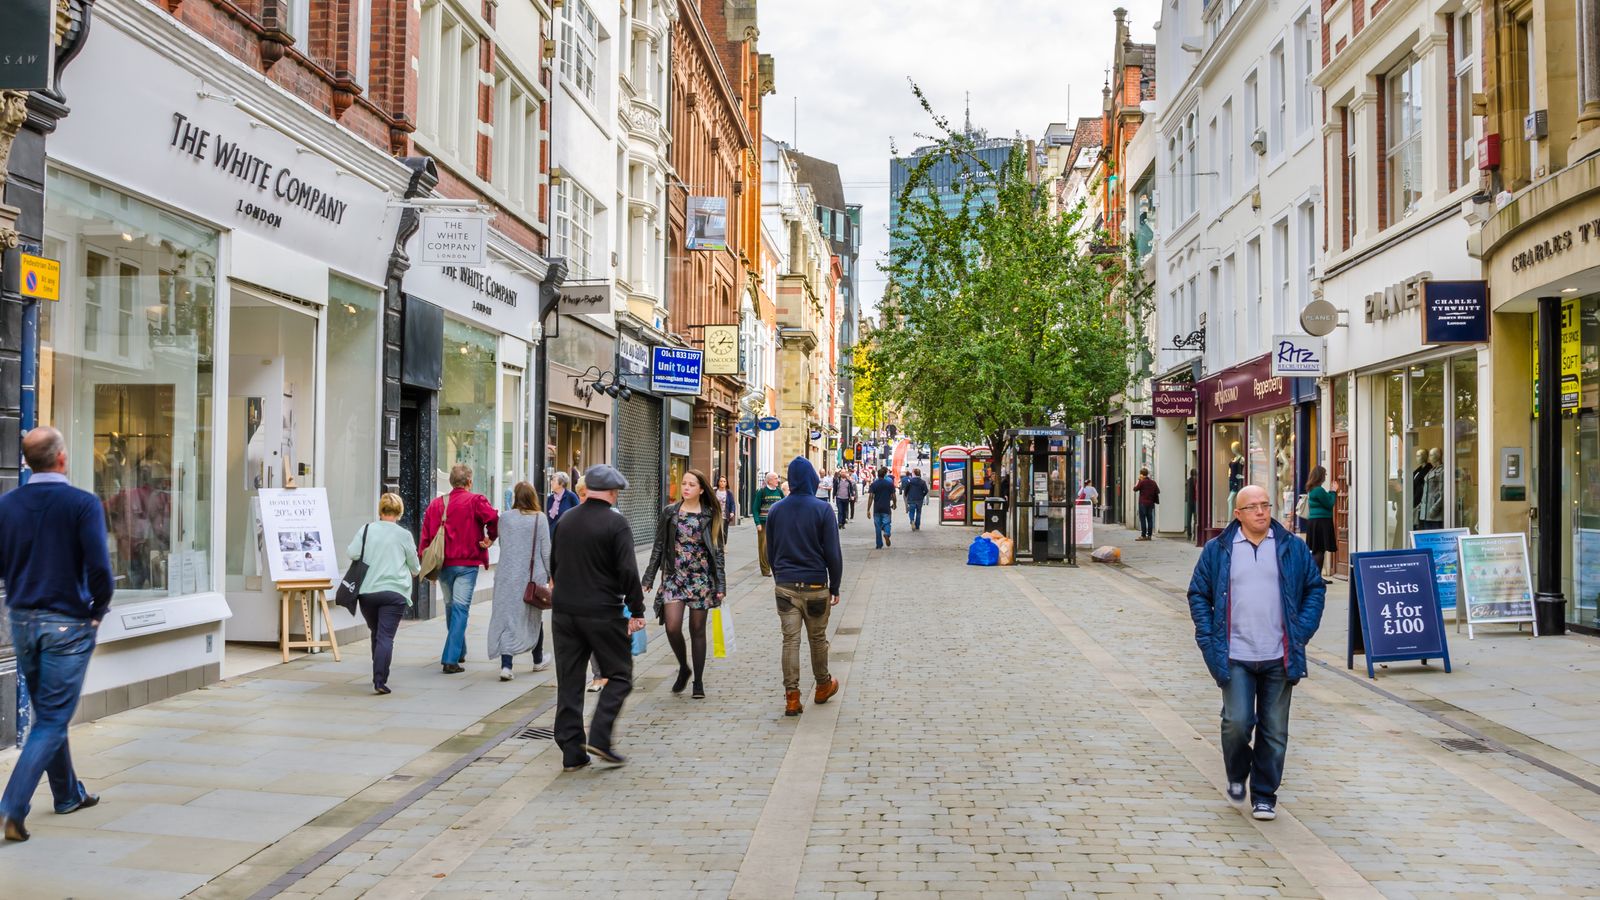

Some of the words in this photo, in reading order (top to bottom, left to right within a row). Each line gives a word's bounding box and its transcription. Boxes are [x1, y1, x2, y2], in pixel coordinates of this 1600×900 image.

[171, 111, 210, 160] THE
[214, 134, 272, 190] WHITE
[275, 168, 348, 225] COMPANY
[236, 199, 282, 228] LONDON
[444, 221, 462, 229] THE
[437, 232, 469, 240] WHITE
[427, 243, 477, 251] COMPANY
[1511, 230, 1573, 273] CHARLES
[460, 267, 484, 292] WHITE
[486, 275, 518, 308] COMPANY
[472, 300, 492, 315] LONDON
[676, 351, 687, 359] 833
[687, 352, 700, 360] 1197
[658, 361, 676, 372] Unit
[676, 363, 686, 373] To
[686, 364, 699, 375] Let
[1253, 376, 1283, 400] Pepperberry
[1156, 404, 1192, 415] Pepperberry
[273, 508, 293, 517] 20%
[294, 508, 314, 517] OFF
[1377, 581, 1419, 595] Shirts
[1380, 603, 1392, 619] 4
[1395, 601, 1423, 618] for
[1383, 617, 1425, 635] £100
